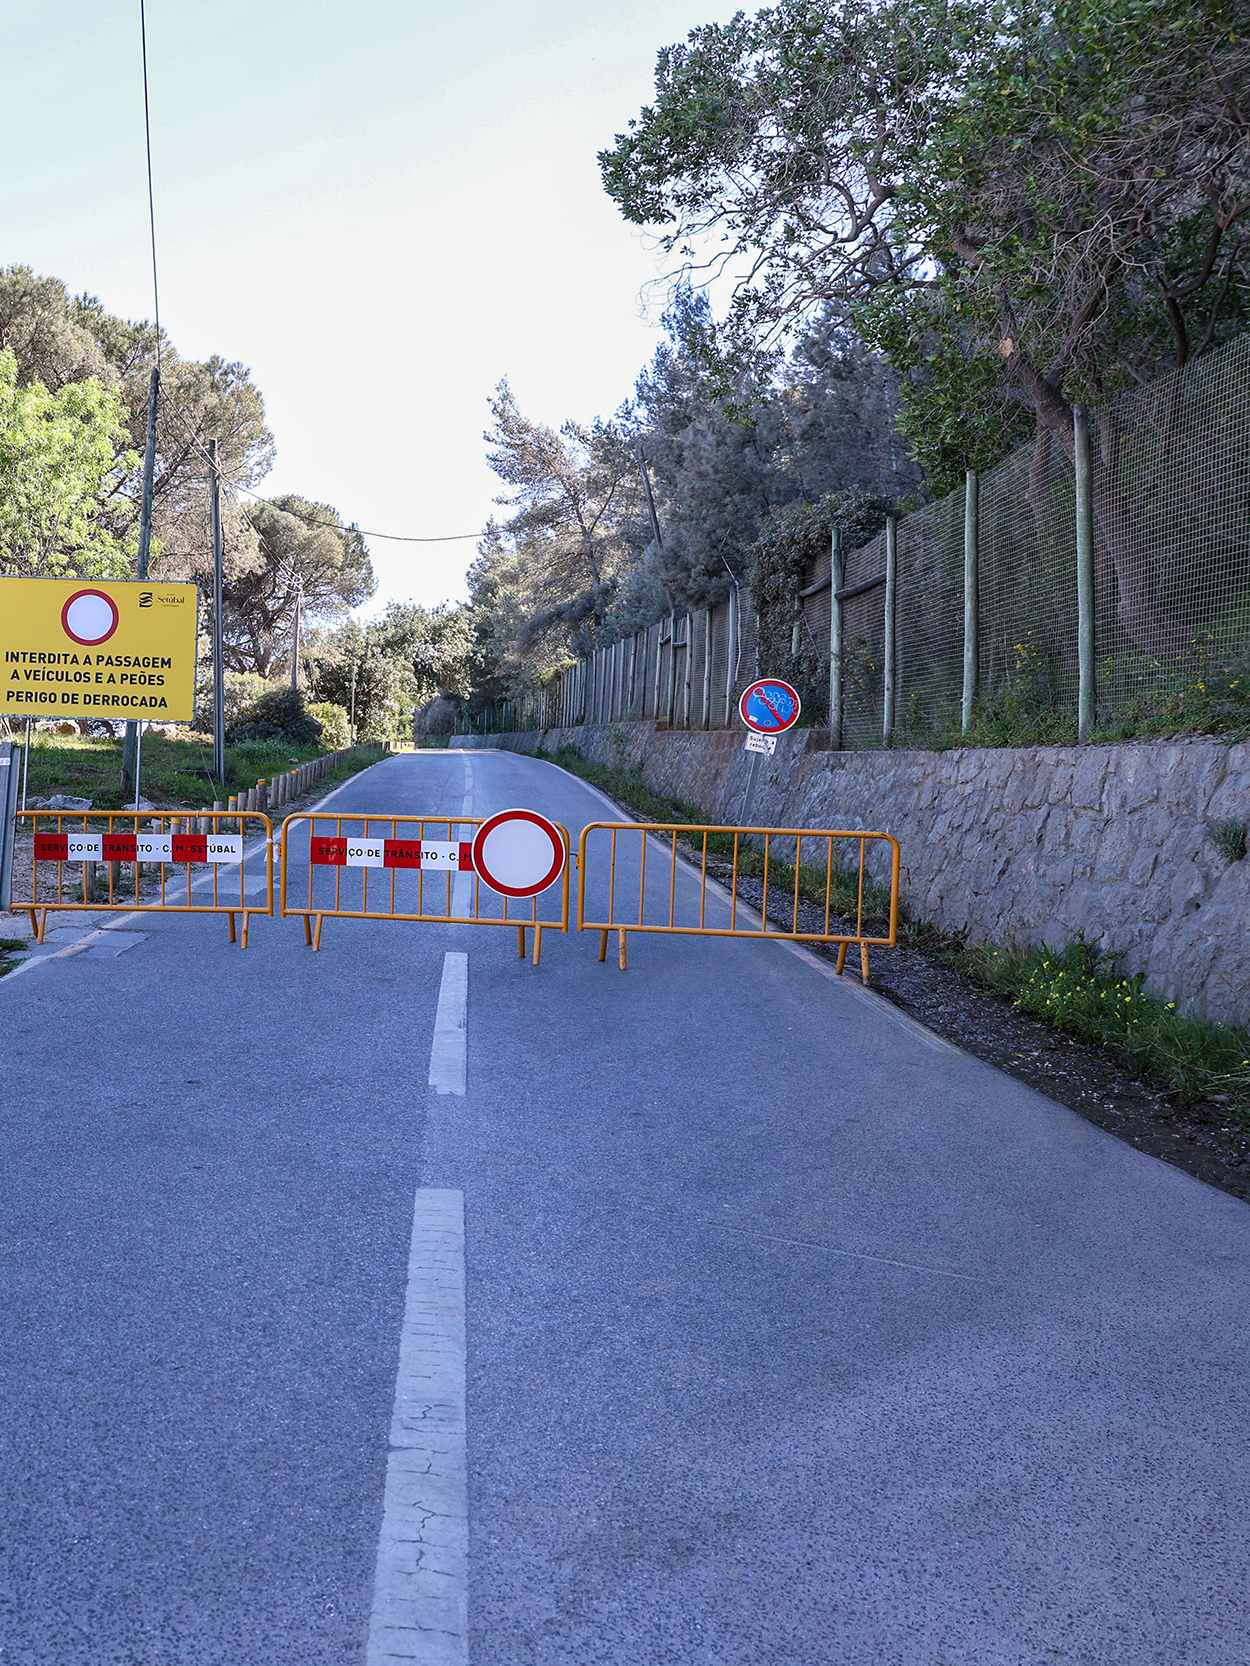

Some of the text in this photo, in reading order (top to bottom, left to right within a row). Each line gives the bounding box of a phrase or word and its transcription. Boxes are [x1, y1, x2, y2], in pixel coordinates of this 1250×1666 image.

[5, 651, 172, 669] INTERDITA A PASSAGEM
[10, 667, 165, 686] A VEÍCULOS E A PEÕES
[6, 690, 168, 708] PERIGO DE DERROCADA
[40, 843, 83, 853] SERVIÇO
[86, 843, 99, 852] DE
[103, 842, 152, 853] TRÂNSITO
[190, 843, 236, 853] SETÚBAL
[317, 846, 366, 859] SERVIÇO
[367, 847, 381, 858] DE
[385, 848, 438, 861] TRÂNSITO
